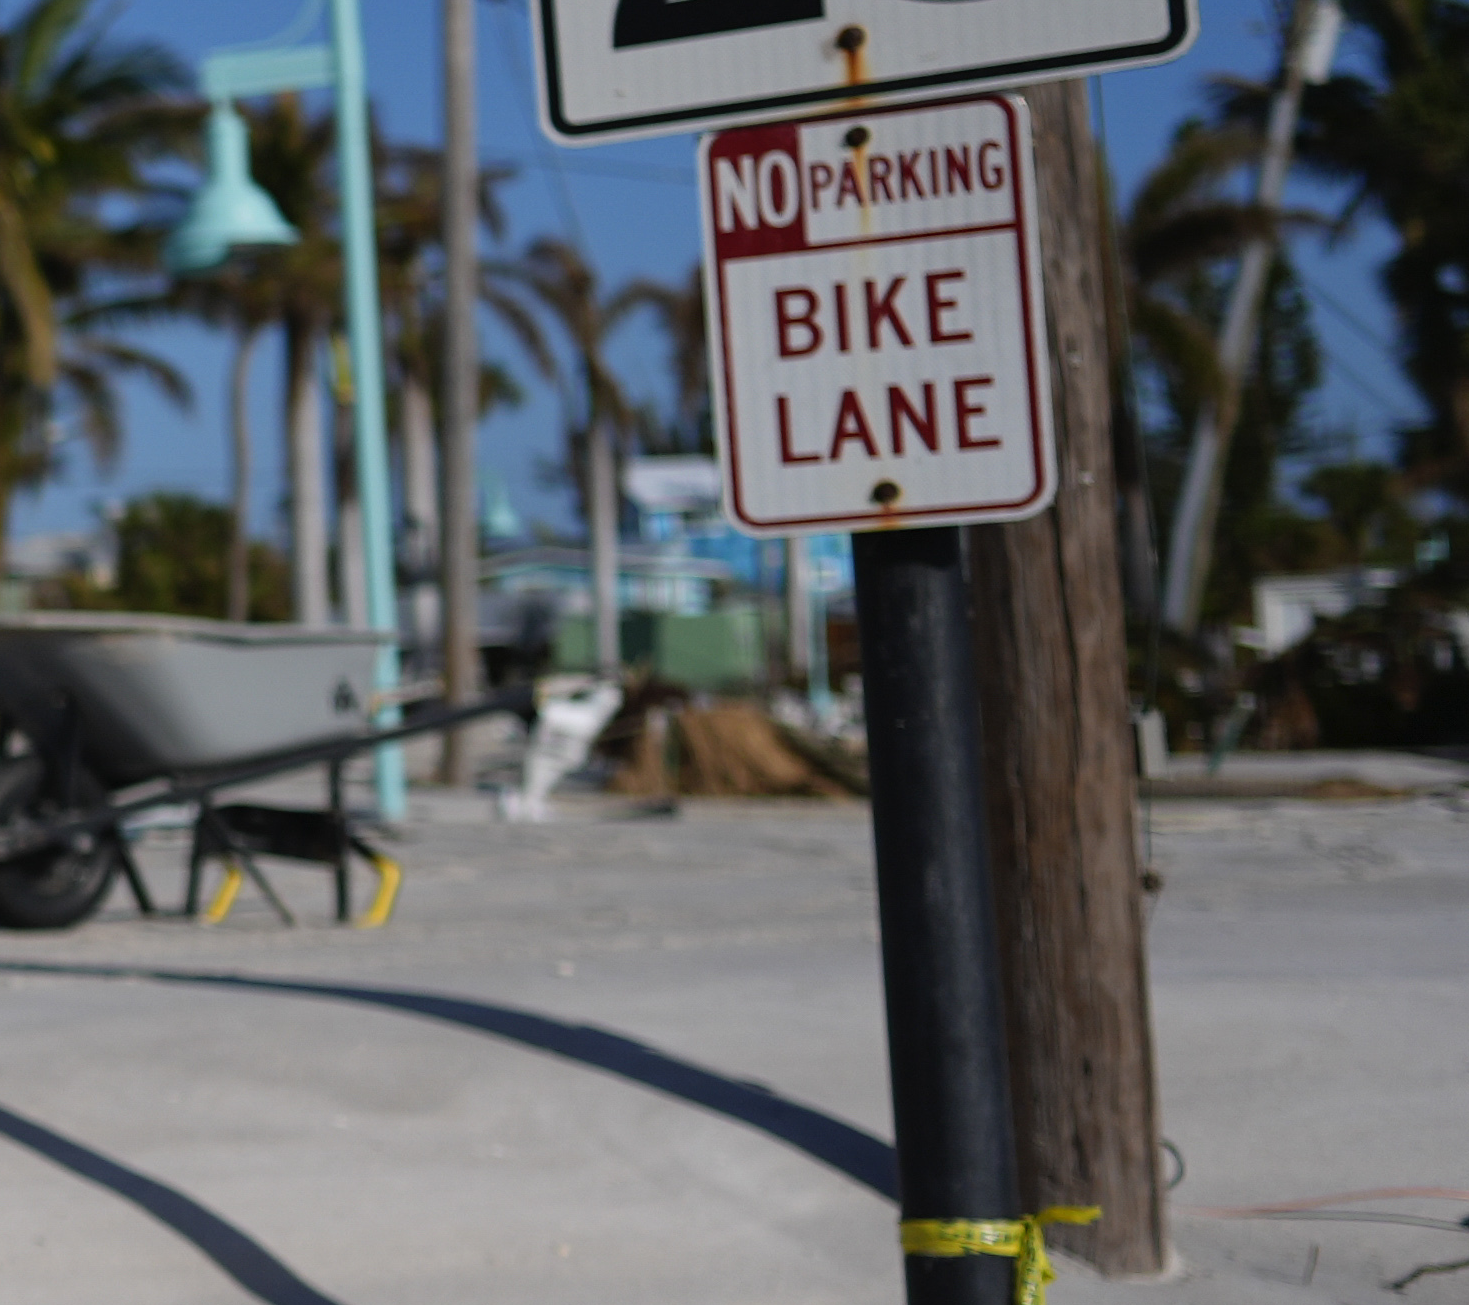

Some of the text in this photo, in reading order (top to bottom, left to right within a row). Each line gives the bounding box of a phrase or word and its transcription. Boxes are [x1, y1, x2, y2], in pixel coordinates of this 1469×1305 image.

[715, 141, 1005, 234] NO PARKING
[773, 269, 973, 361] BIKE
[776, 376, 1003, 467] LANE
